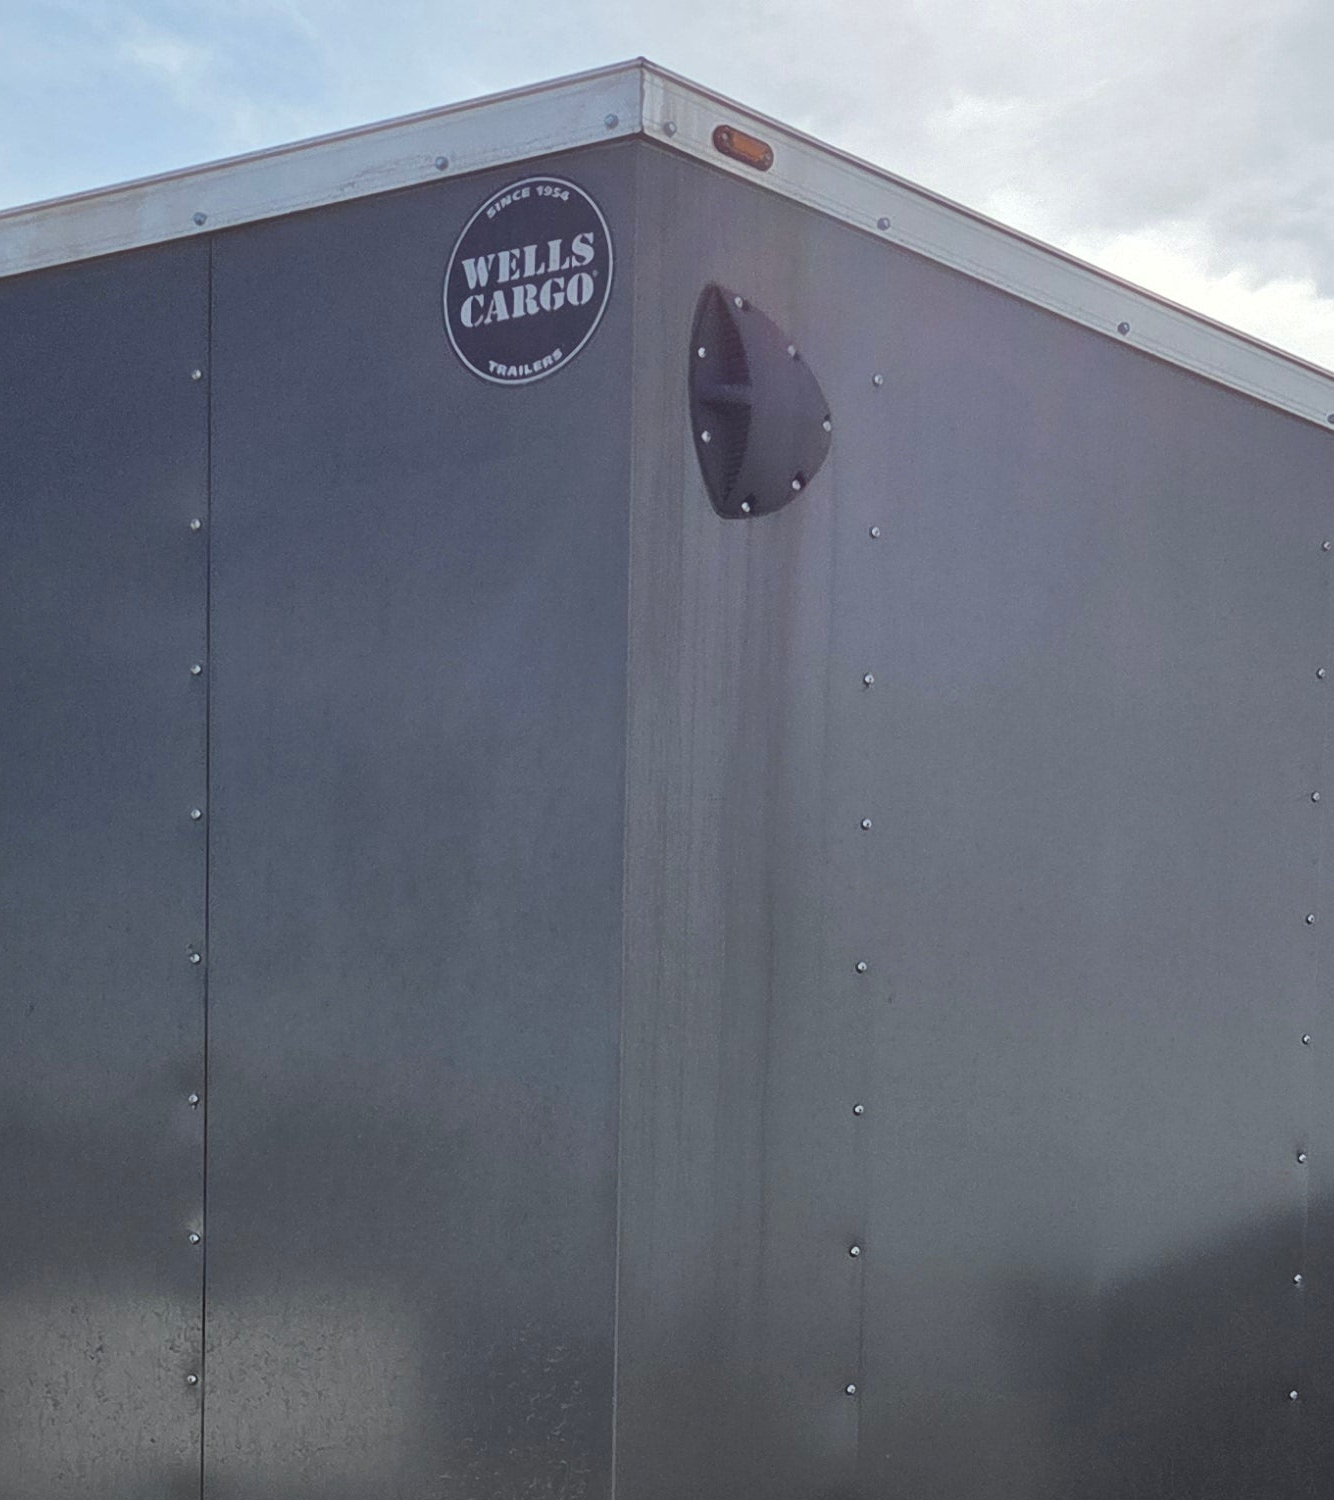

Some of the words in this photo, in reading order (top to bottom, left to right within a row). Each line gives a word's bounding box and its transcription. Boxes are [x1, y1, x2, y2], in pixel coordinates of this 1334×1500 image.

[487, 187, 531, 219] SINCE
[536, 185, 570, 201] 1954
[461, 232, 595, 290] WELLS
[460, 272, 595, 328] CARGO
[488, 348, 563, 377] TRAILERS
